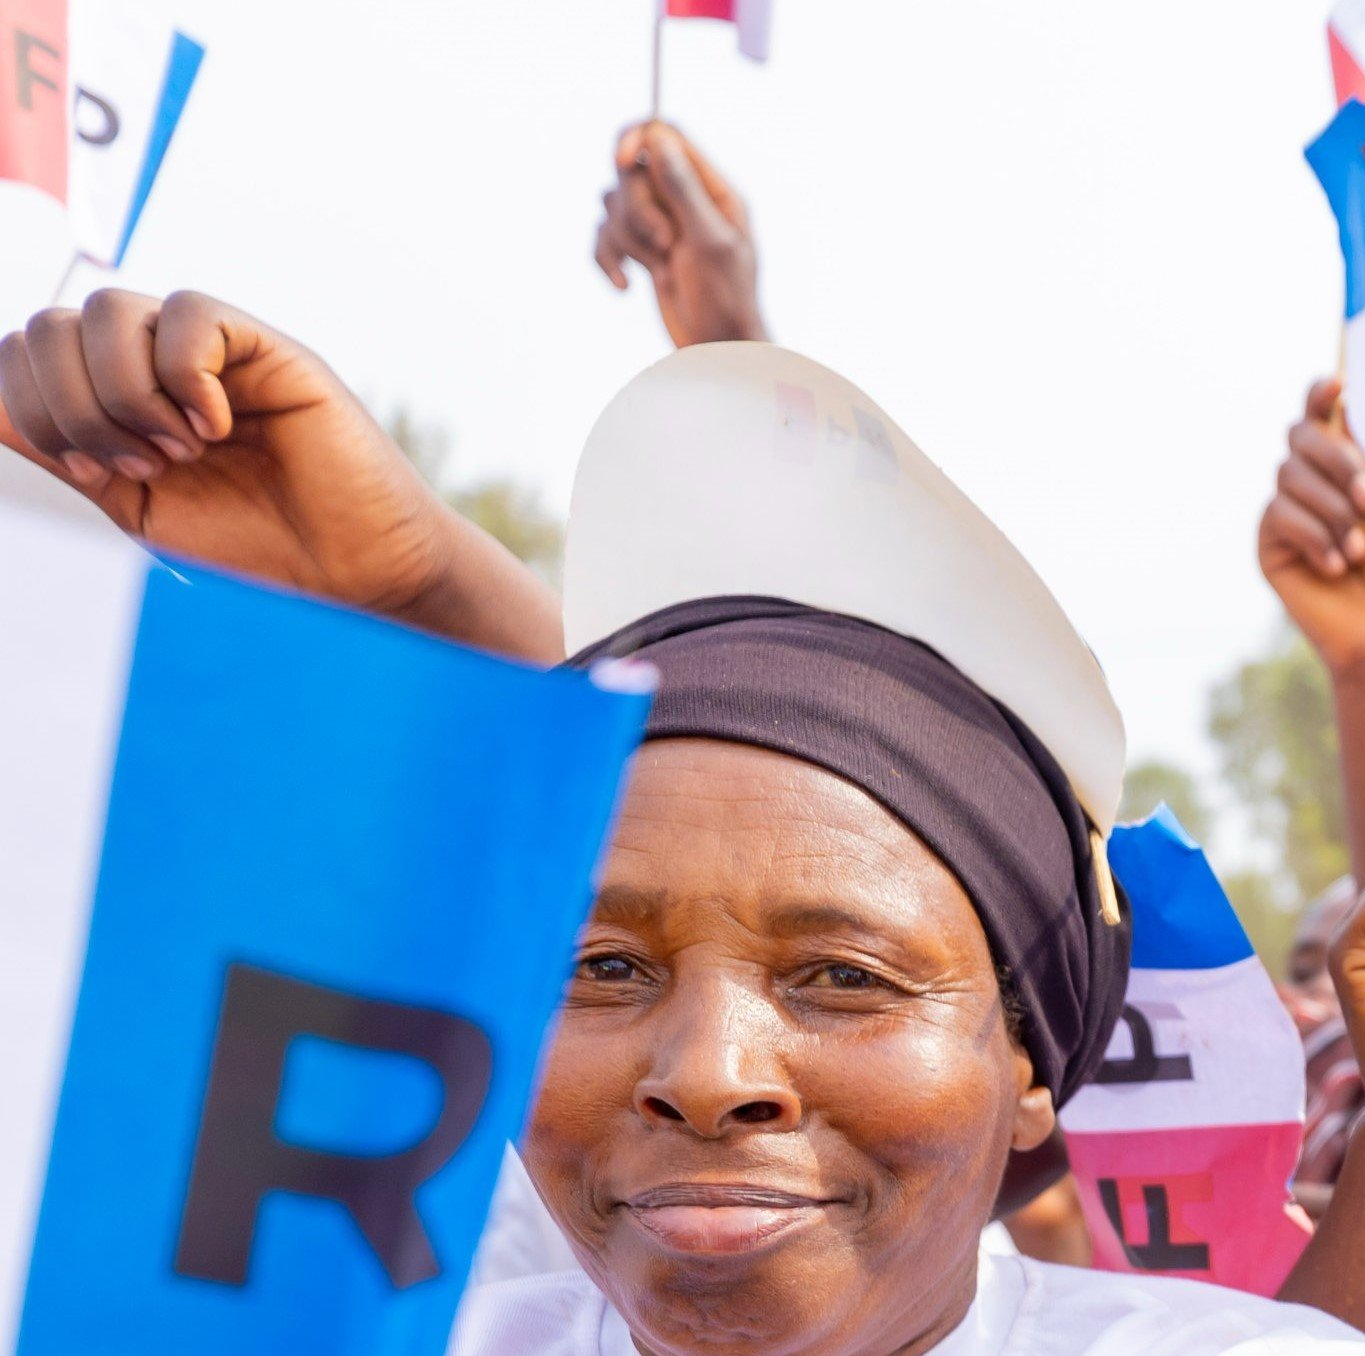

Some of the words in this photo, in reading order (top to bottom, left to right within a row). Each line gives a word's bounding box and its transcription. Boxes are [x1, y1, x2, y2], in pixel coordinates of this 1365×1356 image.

[15, 29, 60, 111] F
[173, 962, 495, 1291] R
[1097, 1177, 1210, 1271] F
